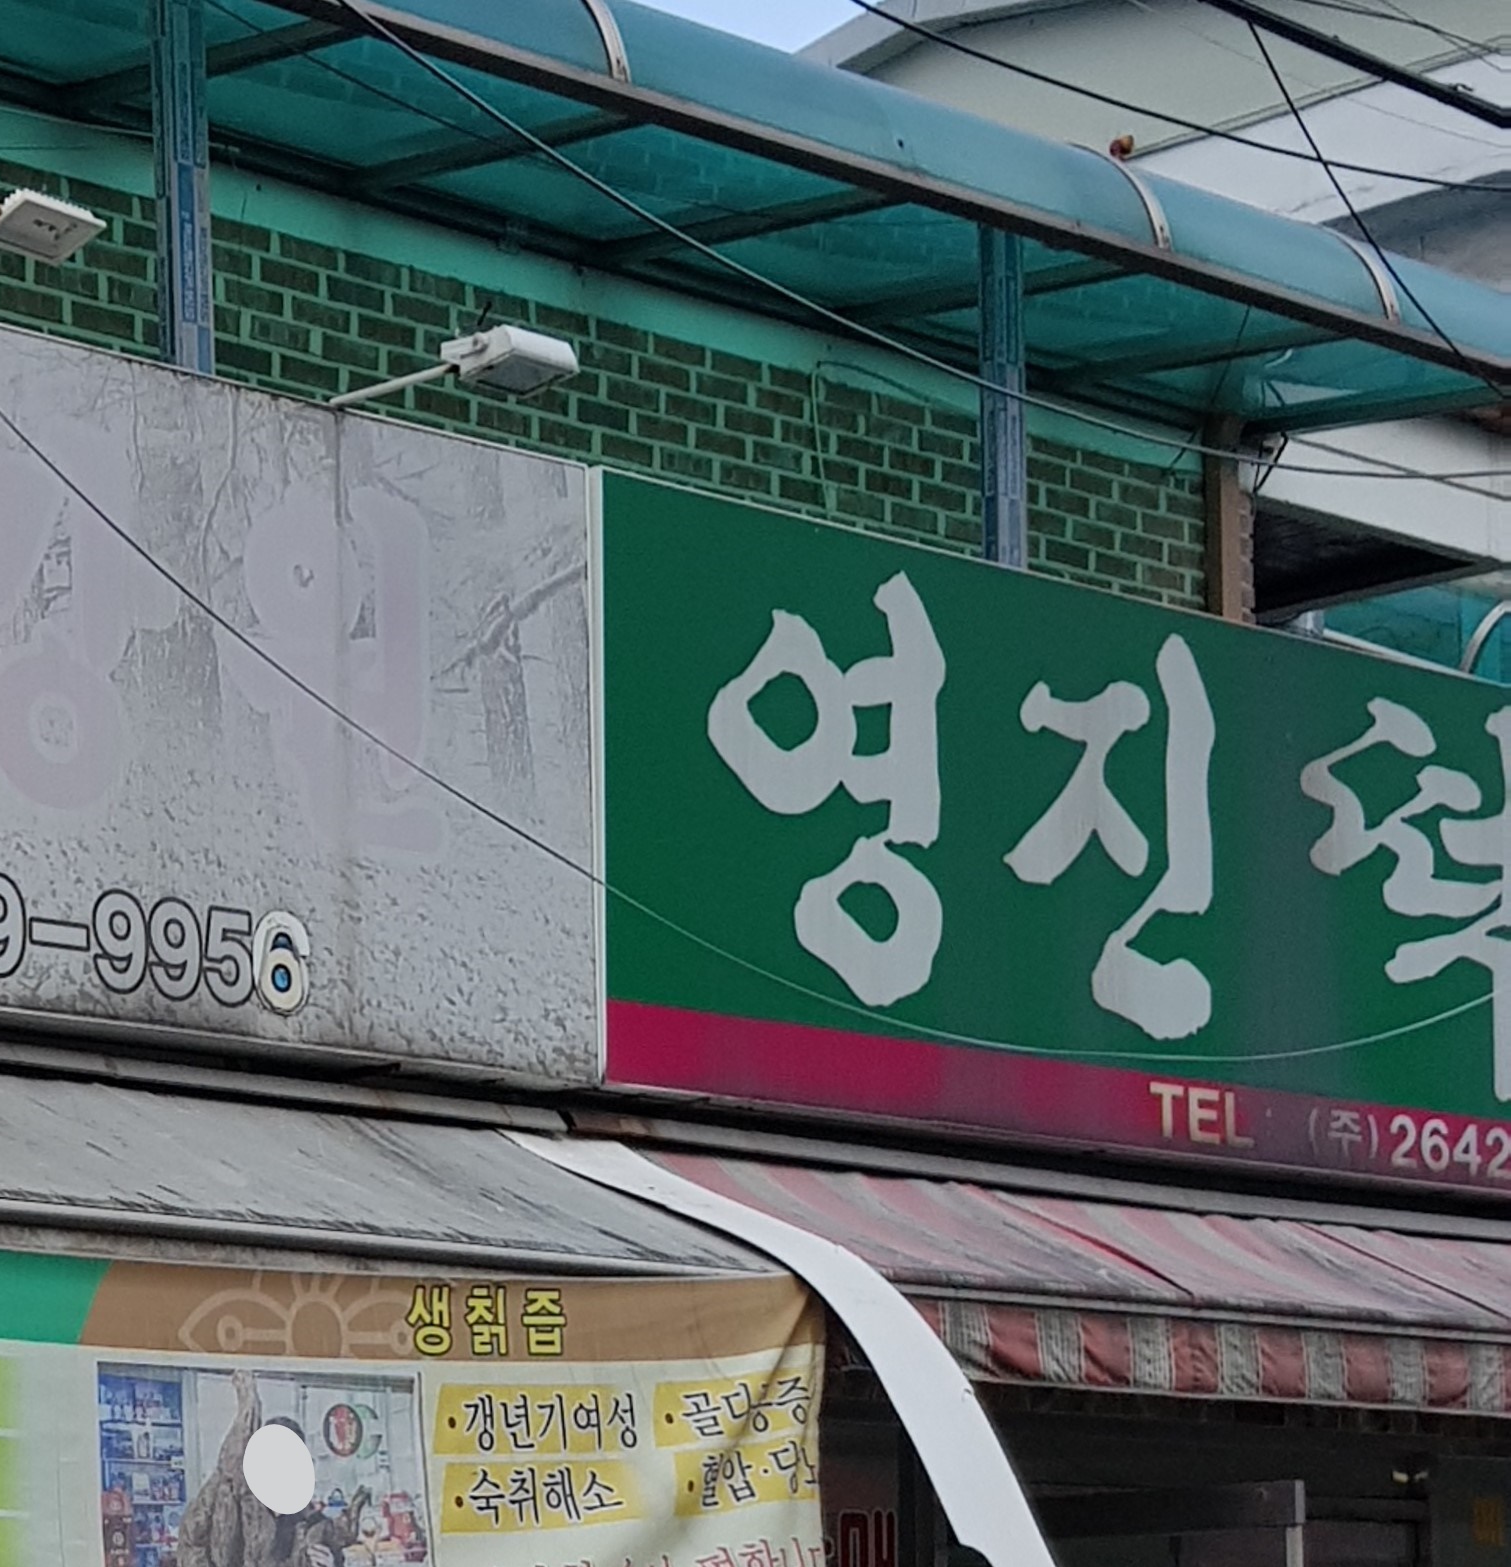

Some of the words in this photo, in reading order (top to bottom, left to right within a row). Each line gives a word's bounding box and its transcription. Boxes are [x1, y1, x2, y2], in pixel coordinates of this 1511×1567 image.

[1149, 1080, 1256, 1150] TEL
[463, 1392, 639, 1453] 갱년기여성
[468, 1467, 625, 1526] 숙취해소
